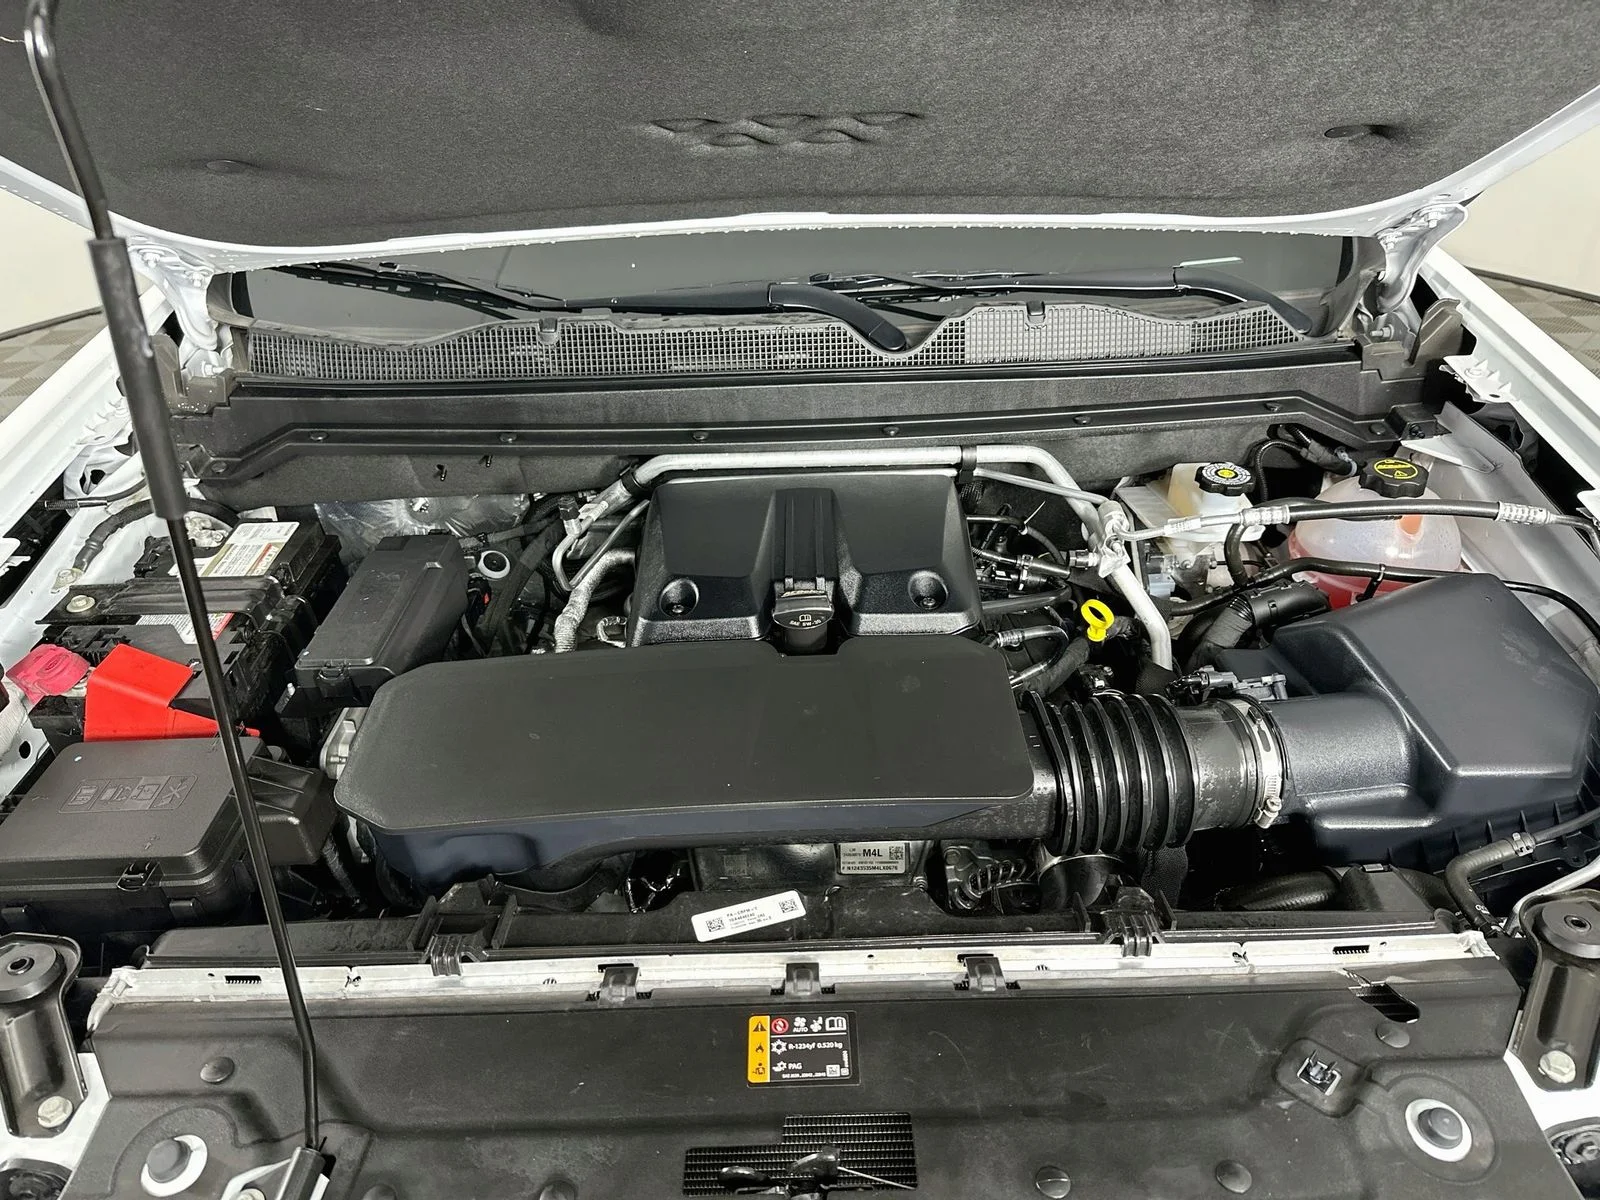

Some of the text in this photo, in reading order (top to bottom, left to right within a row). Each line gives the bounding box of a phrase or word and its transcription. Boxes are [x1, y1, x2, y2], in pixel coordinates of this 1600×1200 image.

[862, 848, 883, 857] M4L
[788, 1042, 816, 1050] R-1234yf
[788, 1062, 803, 1070] PAG
